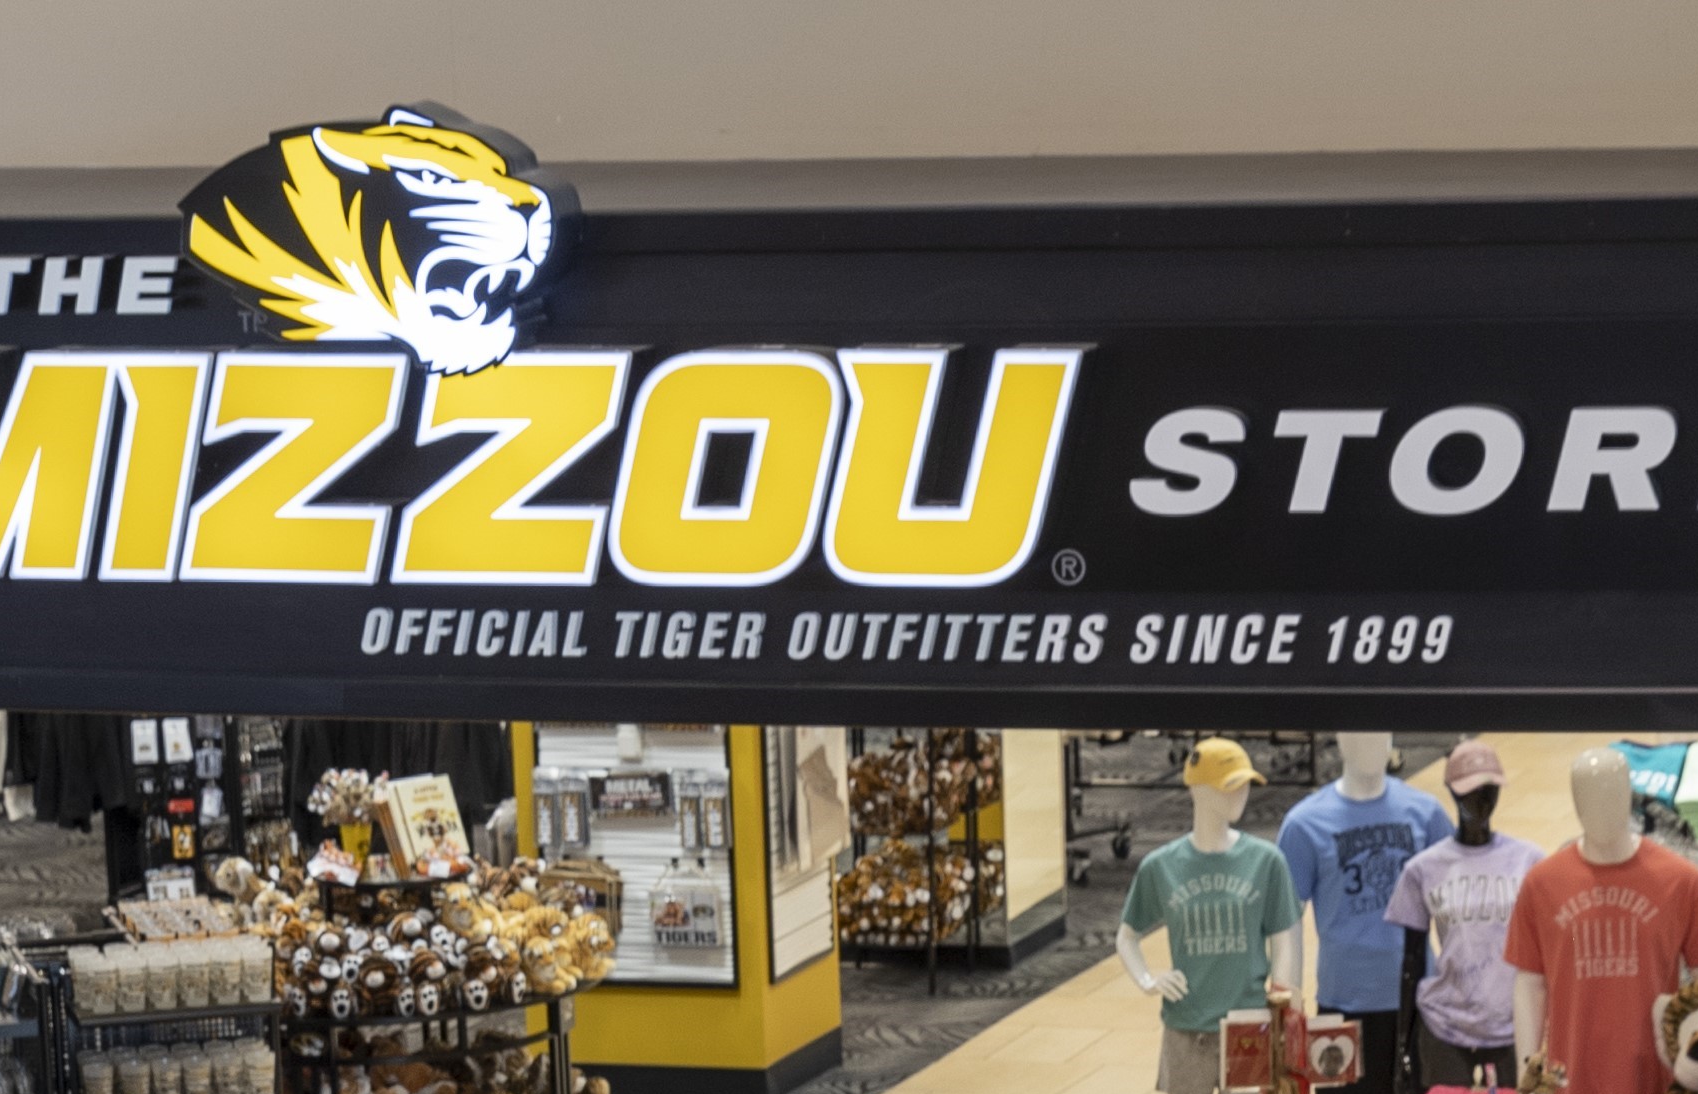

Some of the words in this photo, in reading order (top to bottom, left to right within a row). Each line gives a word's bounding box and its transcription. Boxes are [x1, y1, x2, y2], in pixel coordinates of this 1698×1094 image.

[360, 606, 588, 658] OFFICIAL
[615, 610, 767, 660] TIGER
[787, 611, 1108, 664] OUTFITTERS
[1130, 613, 1302, 664] SINCE
[1326, 615, 1454, 664] 1899
[1169, 872, 1262, 912] MISSOURI
[1554, 885, 1660, 930] MISSOURI
[655, 929, 718, 945] TIGERS
[1184, 933, 1248, 956] TIGERS
[1574, 958, 1640, 980] TIGERS
